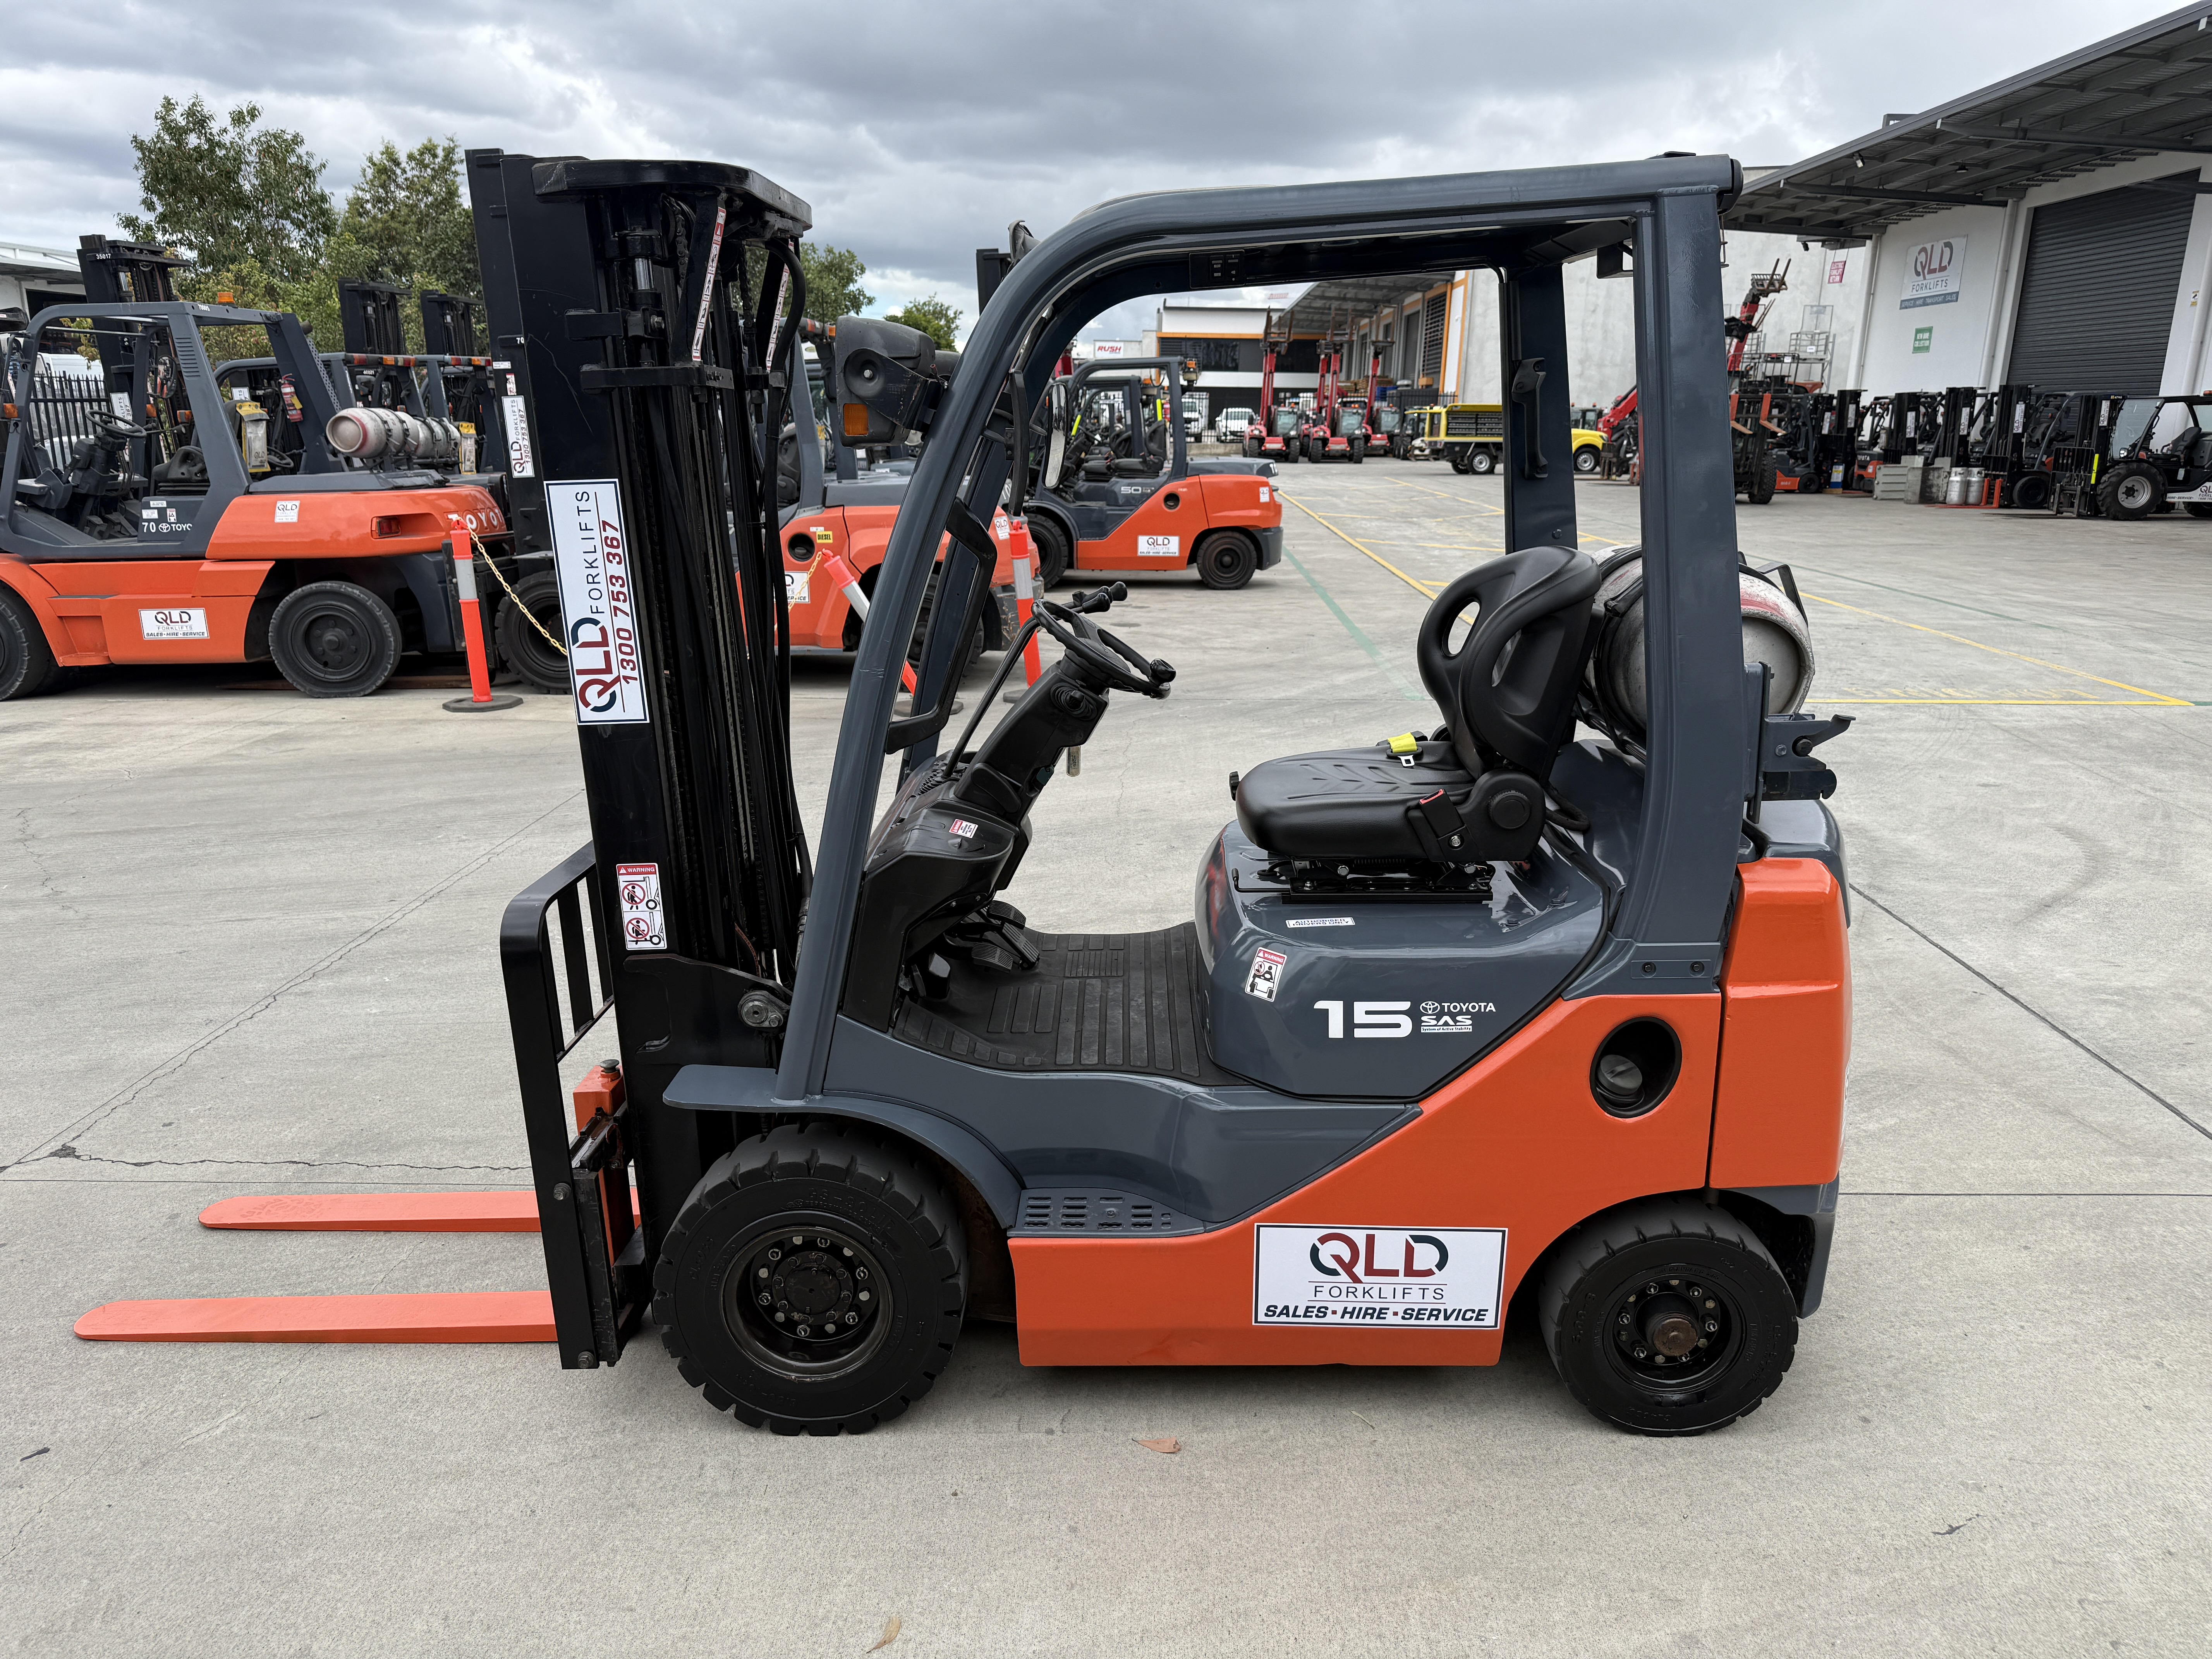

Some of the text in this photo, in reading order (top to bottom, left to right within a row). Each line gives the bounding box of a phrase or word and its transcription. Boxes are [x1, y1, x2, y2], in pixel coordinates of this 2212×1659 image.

[1914, 241, 1953, 280] QLD
[1911, 279, 1948, 293] FORKLIFTS
[510, 399, 526, 473] QLD FORKLIFTS
[278, 504, 297, 512] QLD
[142, 522, 156, 532] 70
[1147, 537, 1170, 547] QLD
[570, 491, 620, 713] QLD FORKLIFTS
[602, 520, 638, 685] 1300 753 367
[155, 611, 191, 626] QLD
[1264, 953, 1284, 963] WARNING
[1314, 1000, 1496, 1038] 15 TOYOTA
[1421, 1015, 1472, 1025] SAS
[1309, 1232, 1449, 1283] QLD
[1314, 1285, 1444, 1300] FORKLIFTS
[1264, 1304, 1489, 1322] SALES HIRE SERVICE
